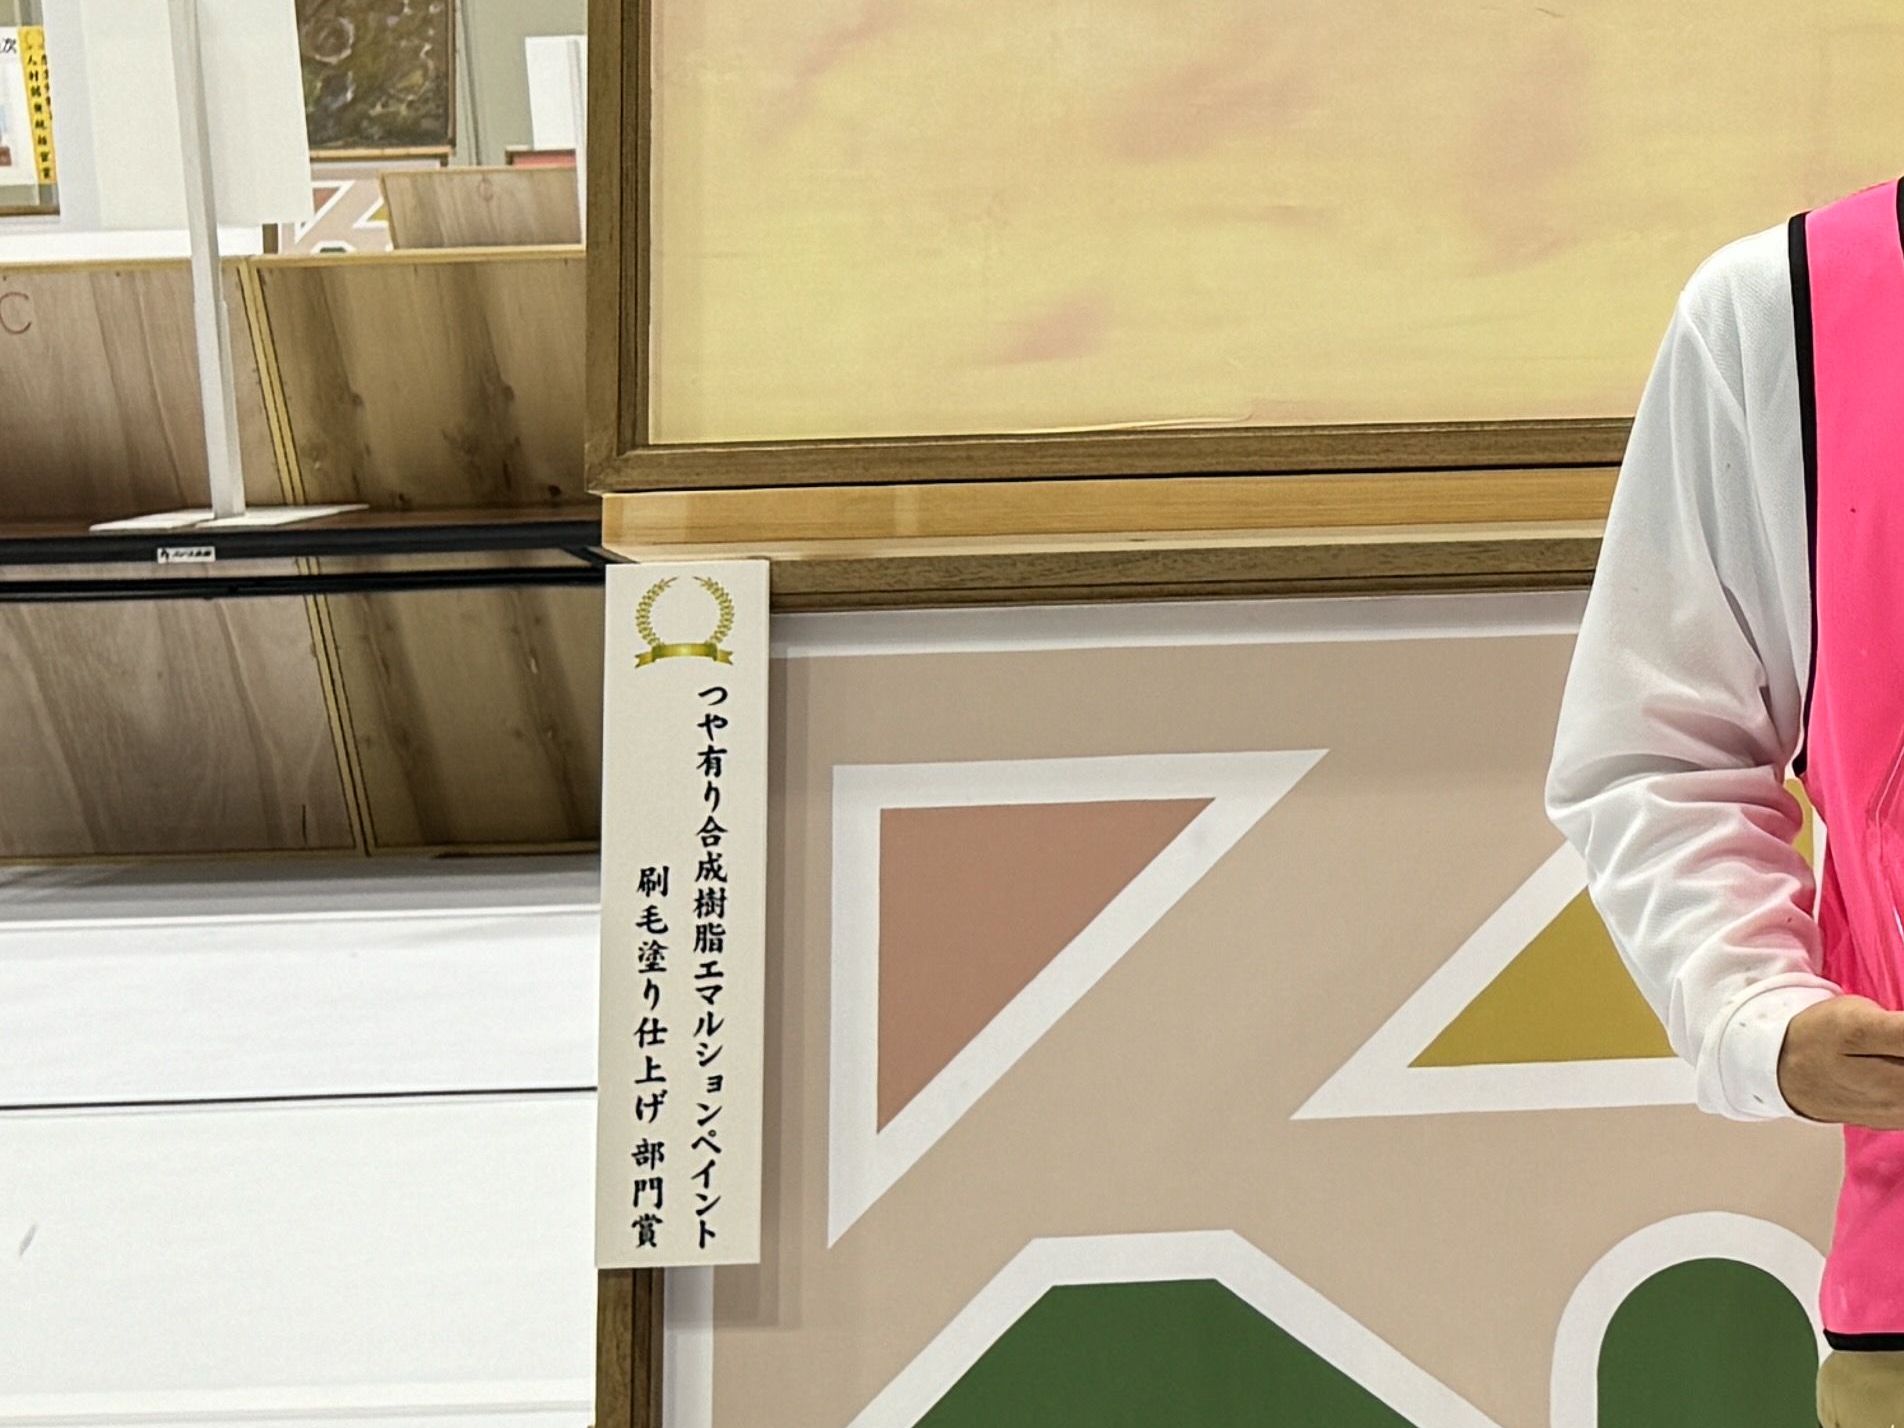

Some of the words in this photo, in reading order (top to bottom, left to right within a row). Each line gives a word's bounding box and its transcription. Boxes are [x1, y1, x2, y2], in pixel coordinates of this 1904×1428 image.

[633, 866, 669, 1124] 刷毛塗り仕上げ
[691, 685, 729, 1250] つや有り合成樹脂エマルションペイント
[631, 1137, 665, 1249] 部門賞
